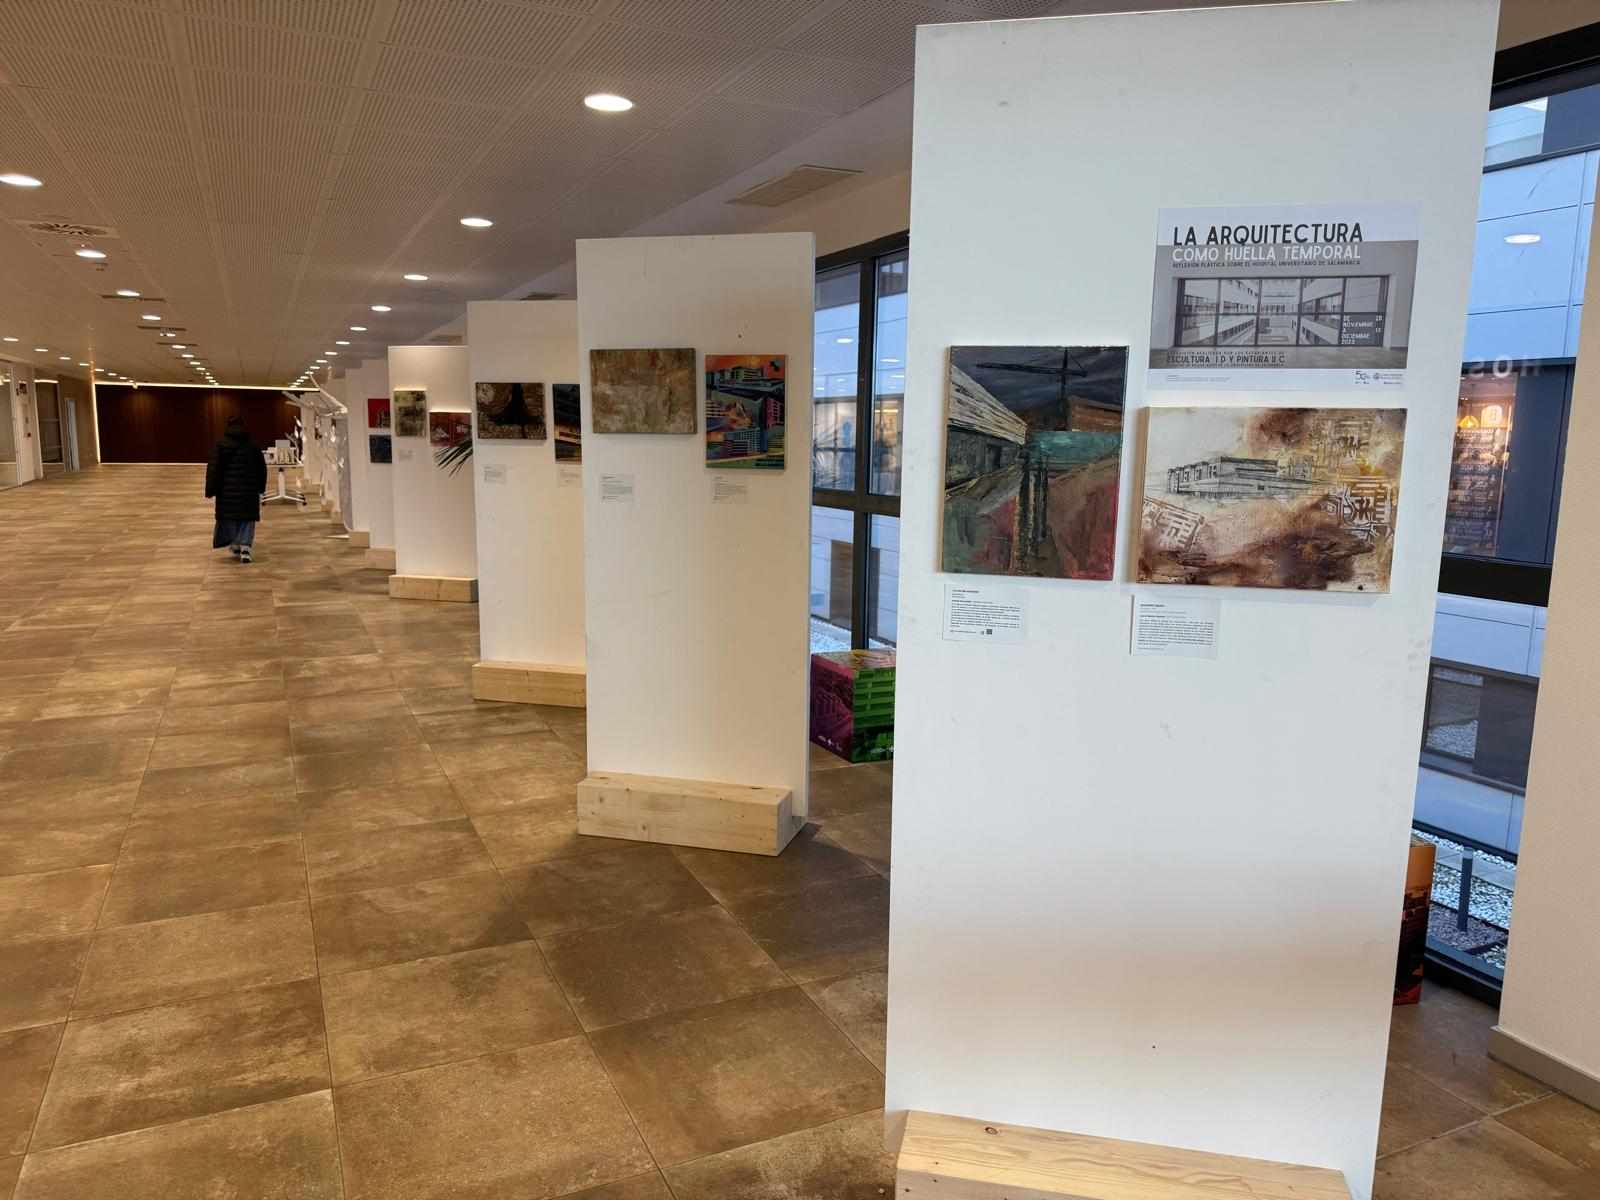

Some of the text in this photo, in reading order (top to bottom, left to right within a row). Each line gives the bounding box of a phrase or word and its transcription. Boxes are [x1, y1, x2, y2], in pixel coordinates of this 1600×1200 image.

[1174, 222, 1363, 246] LA ARQUITECTURA
[1172, 245, 1361, 262] COMO HUELLA TEMPORAL
[1167, 355, 1210, 363] ESCULTURA
[1221, 355, 1226, 363] D
[1229, 355, 1234, 363] Y
[1236, 355, 1269, 363] PINTURA
[1279, 355, 1285, 363] C
